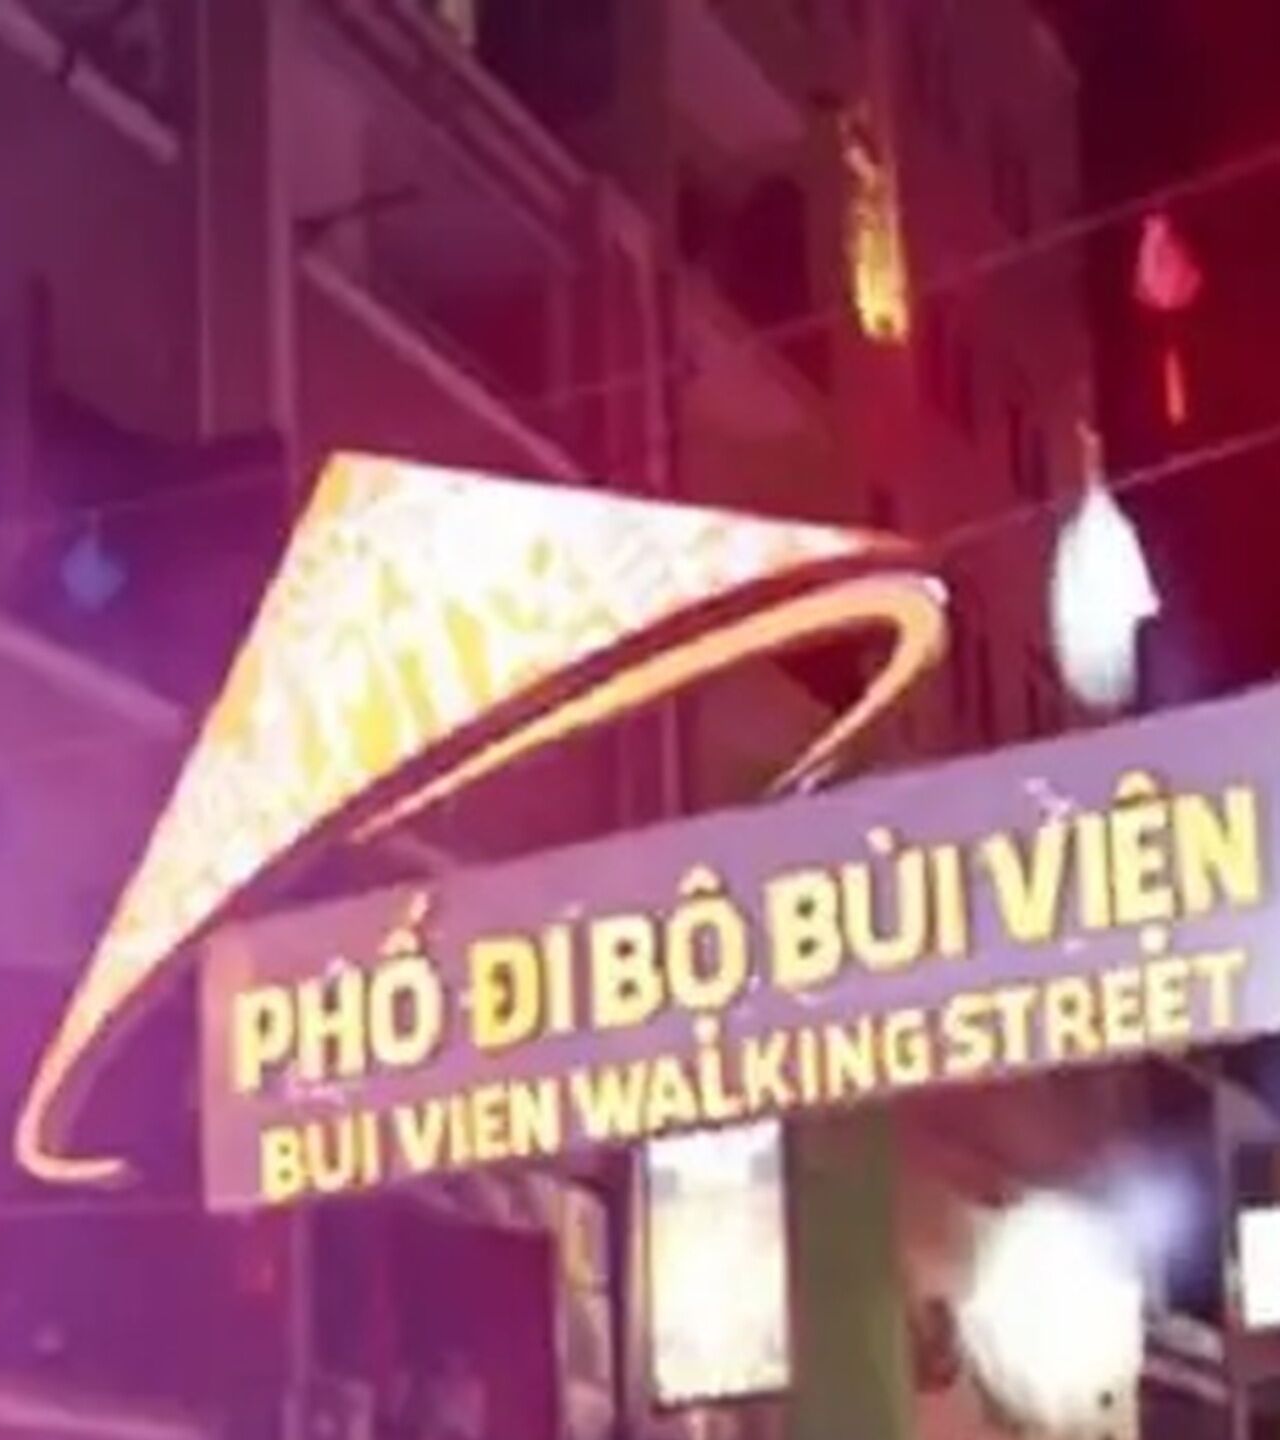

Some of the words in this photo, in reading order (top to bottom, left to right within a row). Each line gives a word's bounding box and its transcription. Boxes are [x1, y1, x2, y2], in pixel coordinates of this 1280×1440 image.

[232, 892, 442, 1094] PHỐ
[586, 864, 748, 1048] BỘ
[763, 826, 968, 994] BÙI
[258, 1108, 384, 1203] BUI
[392, 1076, 562, 1175] VIEN
[568, 1010, 932, 1142] WALKING
[942, 944, 1248, 1076] STREET
